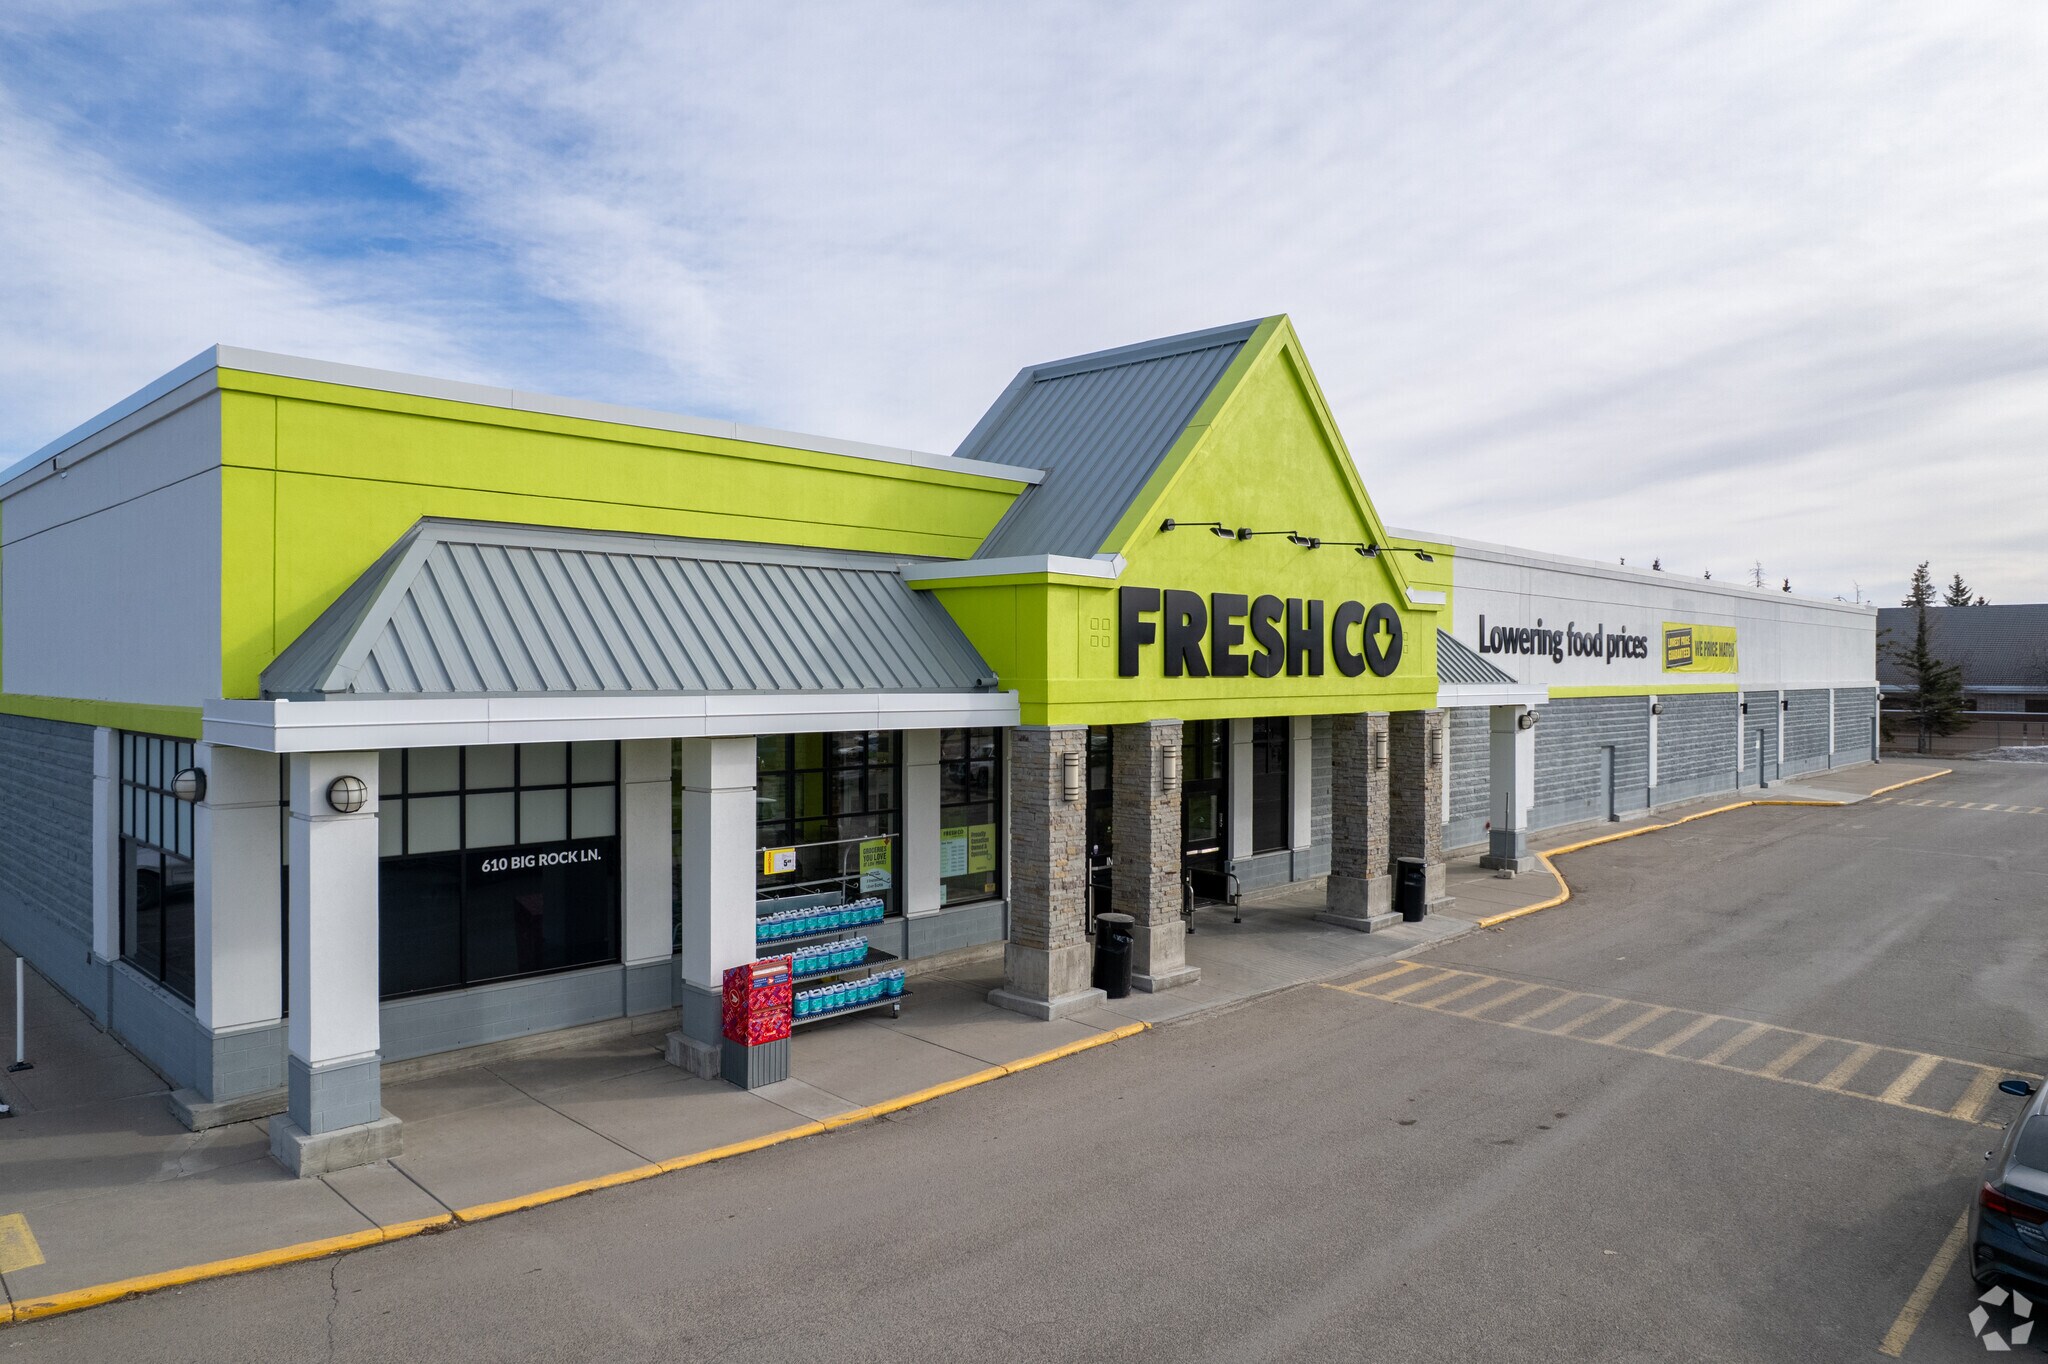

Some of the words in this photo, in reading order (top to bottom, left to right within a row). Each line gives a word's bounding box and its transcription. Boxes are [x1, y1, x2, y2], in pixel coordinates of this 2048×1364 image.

[1479, 614, 1564, 664] Lowering
[1567, 621, 1603, 657] food
[1607, 625, 1648, 665] prices
[863, 845, 887, 854] GROCERIES
[874, 853, 886, 861] LOVE
[481, 857, 508, 873] 610
[511, 855, 536, 869] BIG
[539, 850, 578, 867] ROCK
[580, 848, 602, 862] LN.
